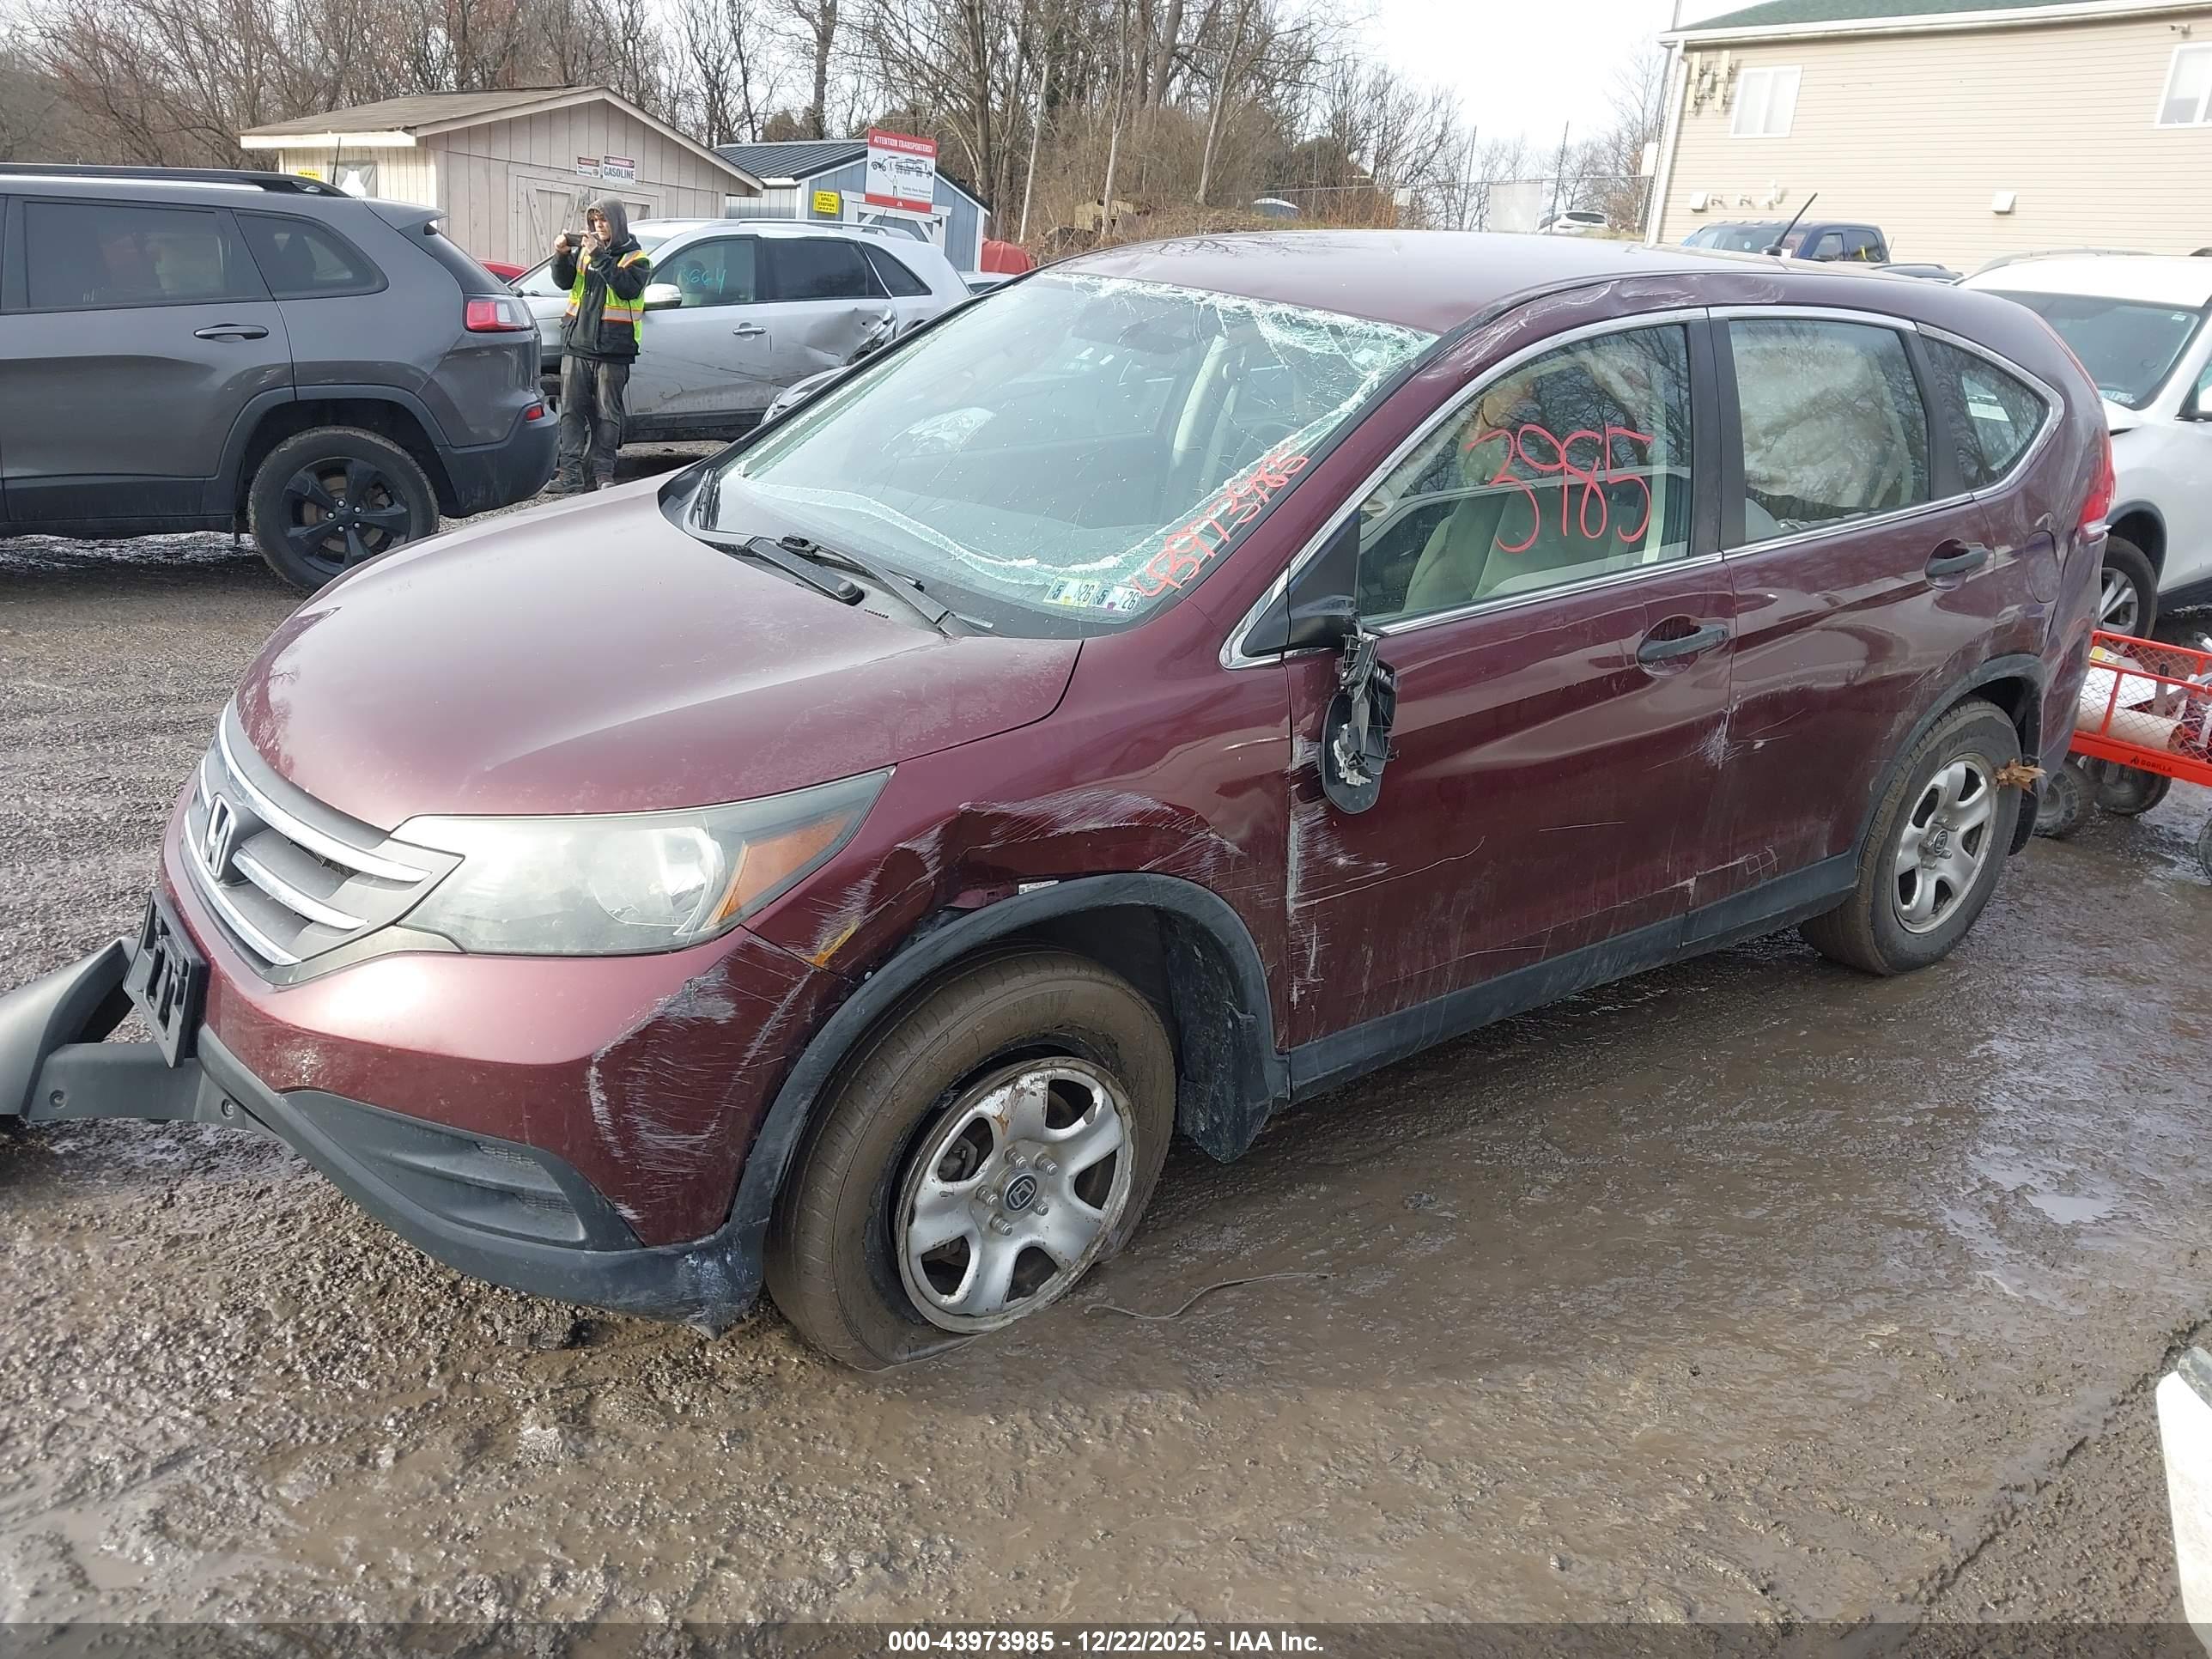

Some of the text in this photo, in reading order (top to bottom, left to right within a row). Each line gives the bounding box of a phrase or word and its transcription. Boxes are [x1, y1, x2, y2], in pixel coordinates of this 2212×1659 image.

[873, 136, 898, 147] ATTENTION
[604, 166, 635, 179] GASOLINE
[1464, 420, 1655, 553] 3985
[1051, 584, 1096, 603] 5 26
[1096, 589, 1139, 611] 5 26
[2140, 759, 2172, 773] GORILLA
